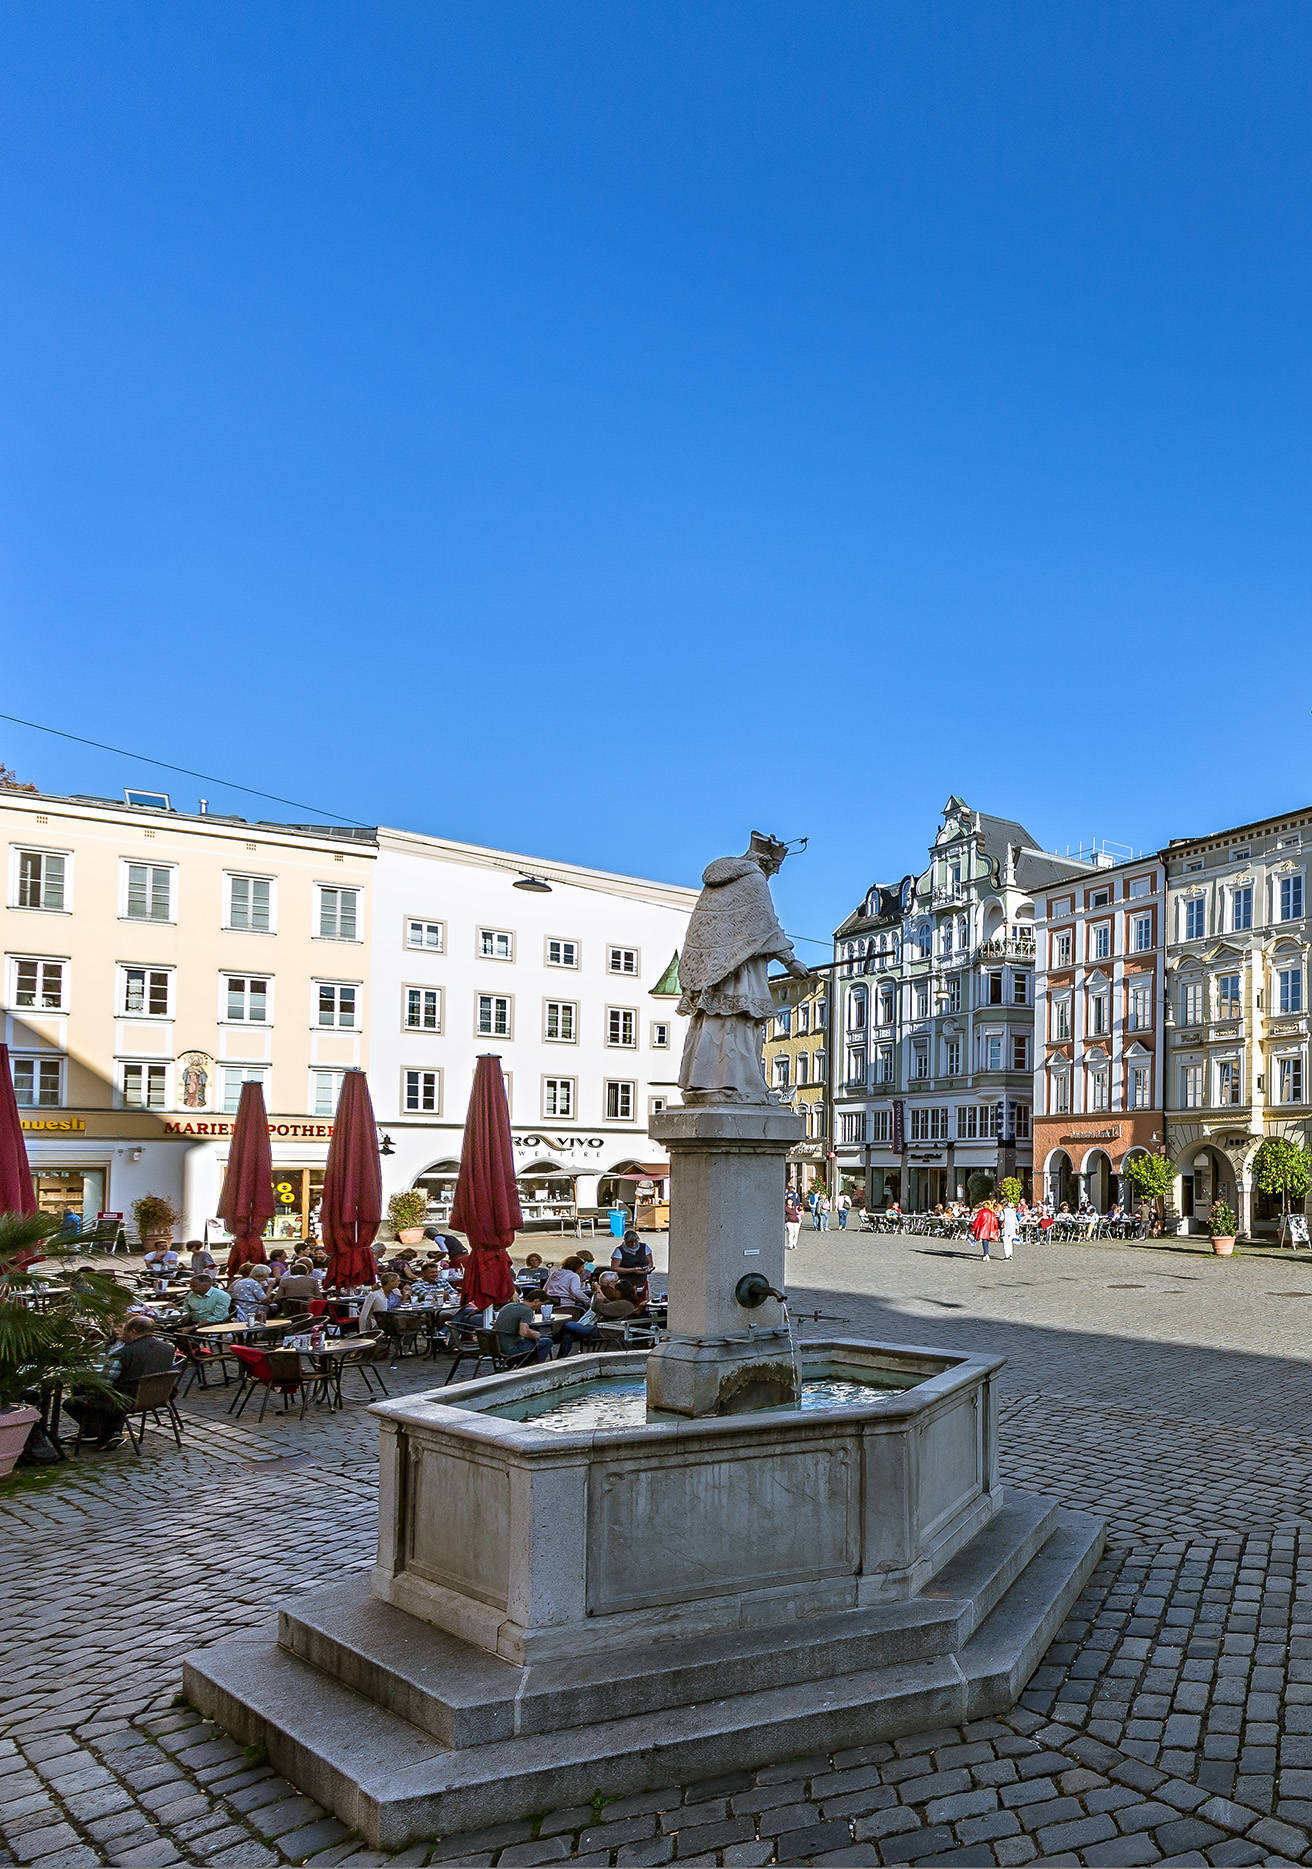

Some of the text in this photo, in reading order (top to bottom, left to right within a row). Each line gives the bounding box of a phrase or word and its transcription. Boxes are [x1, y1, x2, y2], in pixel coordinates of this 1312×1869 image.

[266, 1124, 337, 1137] POTHE
[511, 1136, 605, 1149] RO VIVO
[517, 1150, 601, 1158] WELIERE
